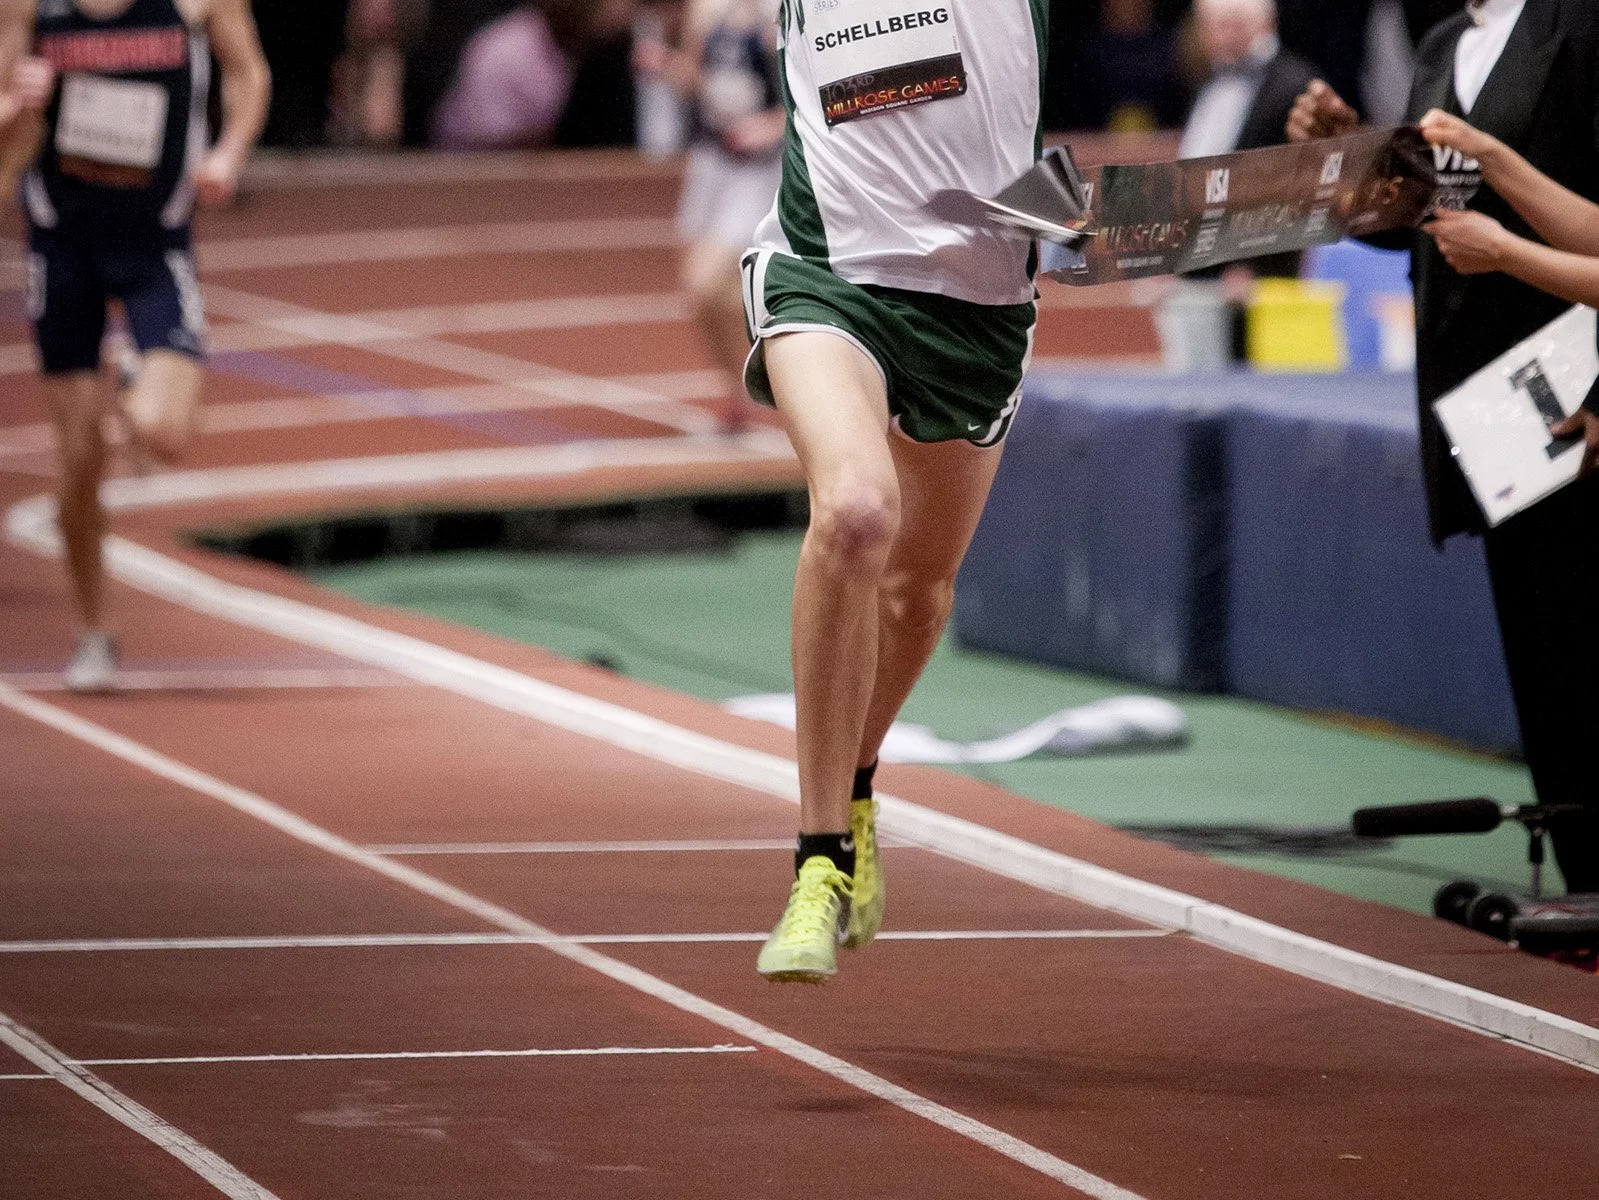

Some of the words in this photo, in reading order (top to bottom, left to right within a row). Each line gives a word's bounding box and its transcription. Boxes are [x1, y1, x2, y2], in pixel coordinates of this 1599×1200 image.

[815, 8, 949, 52] SCHELLBERG
[826, 89, 898, 118] MILLROSE
[901, 75, 960, 98] GAMES
[885, 100, 909, 109] SQUARE
[909, 95, 933, 104] GARDEN
